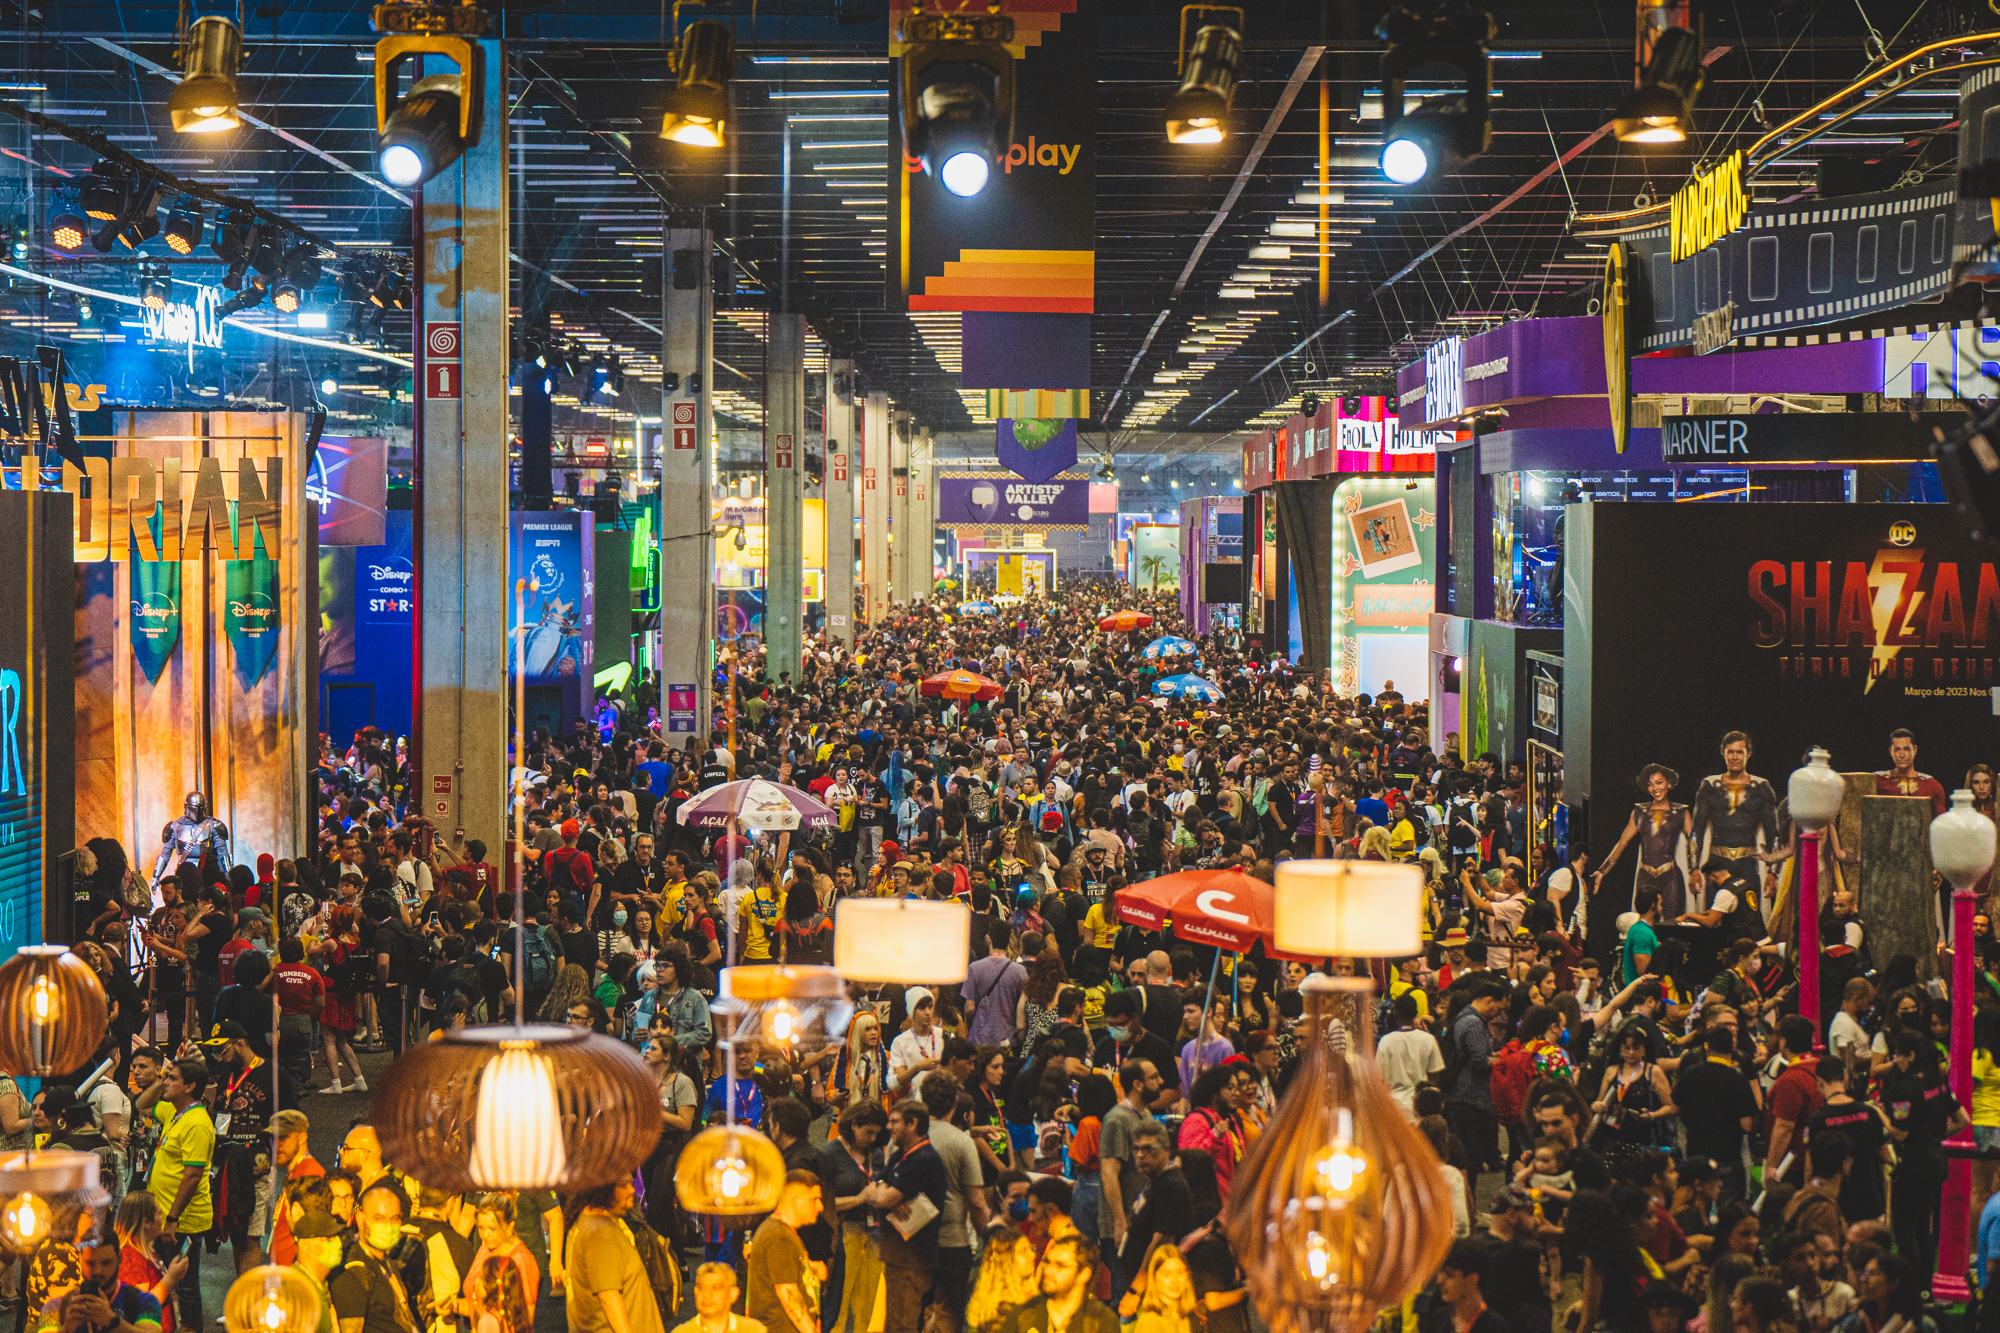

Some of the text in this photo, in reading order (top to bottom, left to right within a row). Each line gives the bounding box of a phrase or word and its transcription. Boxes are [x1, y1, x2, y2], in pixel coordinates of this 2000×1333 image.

[1671, 170, 1715, 264] WARNER
[1005, 484, 1064, 494] ARTISTS'
[1006, 494, 1055, 504] VALLEY
[1892, 526, 1914, 541] DC
[130, 600, 178, 621] Disney+
[229, 600, 277, 621] Disney+
[1361, 595, 1433, 616] HEARTSTOPPER
[1932, 657, 2000, 679] DEUS
[1904, 687, 1933, 698] Março
[1933, 687, 1946, 696] de
[1946, 687, 1968, 697] 2023
[1969, 687, 1987, 697] Nos
[700, 815, 728, 827] AÇAÍ
[811, 815, 829, 827] AÇAÍ
[279, 970, 312, 981] BOMBEIRO
